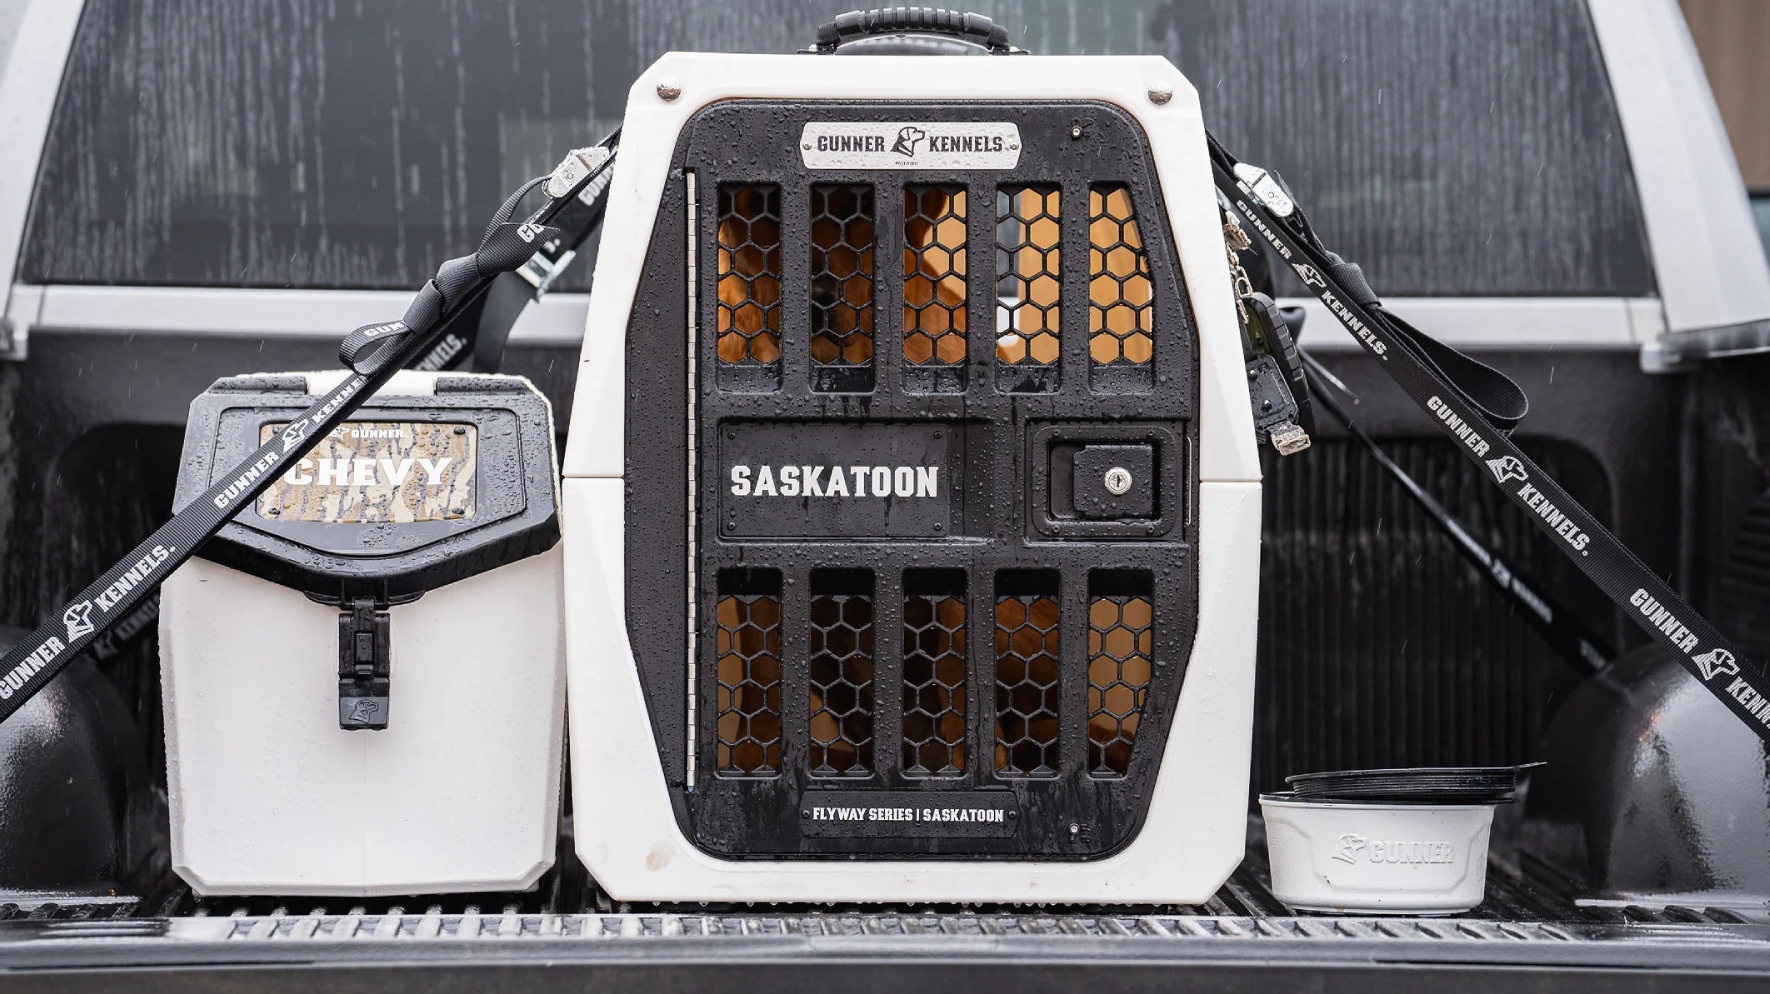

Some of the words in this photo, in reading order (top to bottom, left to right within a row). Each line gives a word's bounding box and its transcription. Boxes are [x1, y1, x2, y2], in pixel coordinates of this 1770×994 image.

[817, 135, 885, 153] GUNNER
[1236, 199, 1292, 260] GUNNER
[1426, 395, 1490, 458] GUNNER
[213, 450, 280, 510] GUNNER
[283, 458, 453, 486] CHEVY
[731, 465, 939, 497] SASKATOON
[0, 635, 66, 700] GUNNER
[1629, 588, 1699, 654] GUNNER
[1725, 676, 1770, 730] KENN
[812, 807, 867, 821] FLYWAY
[868, 807, 913, 821] SERIES
[922, 808, 1004, 822] SASKATOON
[1369, 840, 1454, 864] GUNNER
